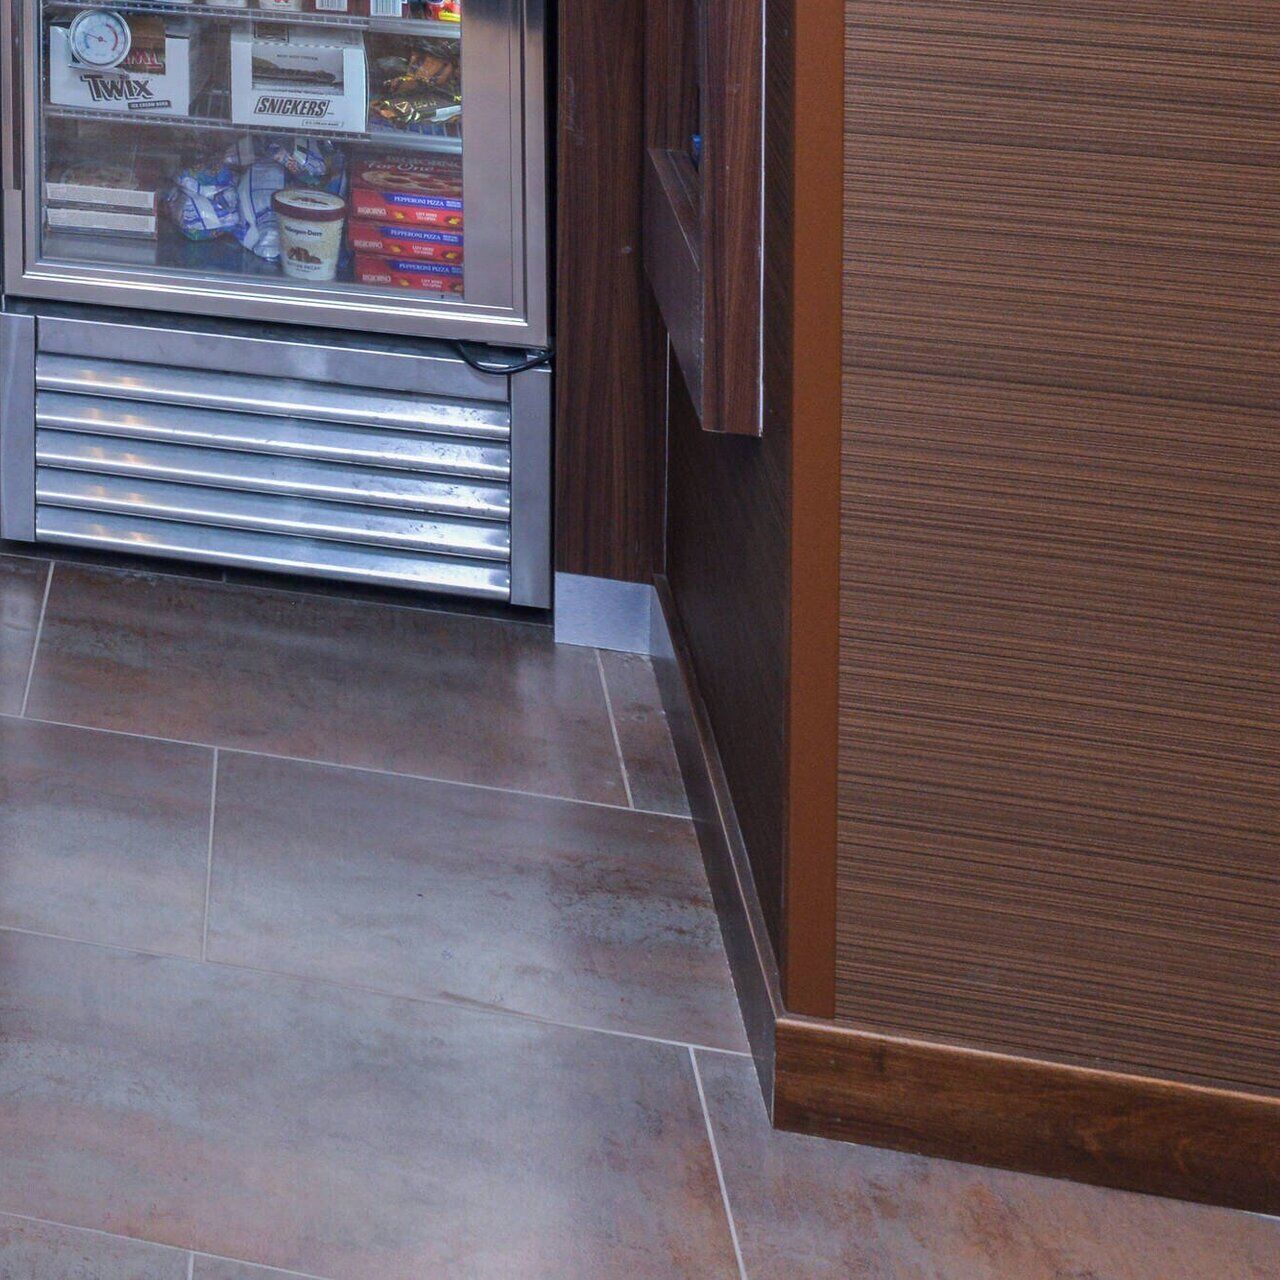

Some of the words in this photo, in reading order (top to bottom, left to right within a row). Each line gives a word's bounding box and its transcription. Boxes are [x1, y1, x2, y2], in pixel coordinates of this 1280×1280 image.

[257, 97, 327, 117] SNICKERS
[397, 163, 433, 171] One
[394, 196, 427, 205] PEPPERONI
[391, 229, 423, 239] PEPPERONI
[399, 263, 431, 272] PEPPERONI
